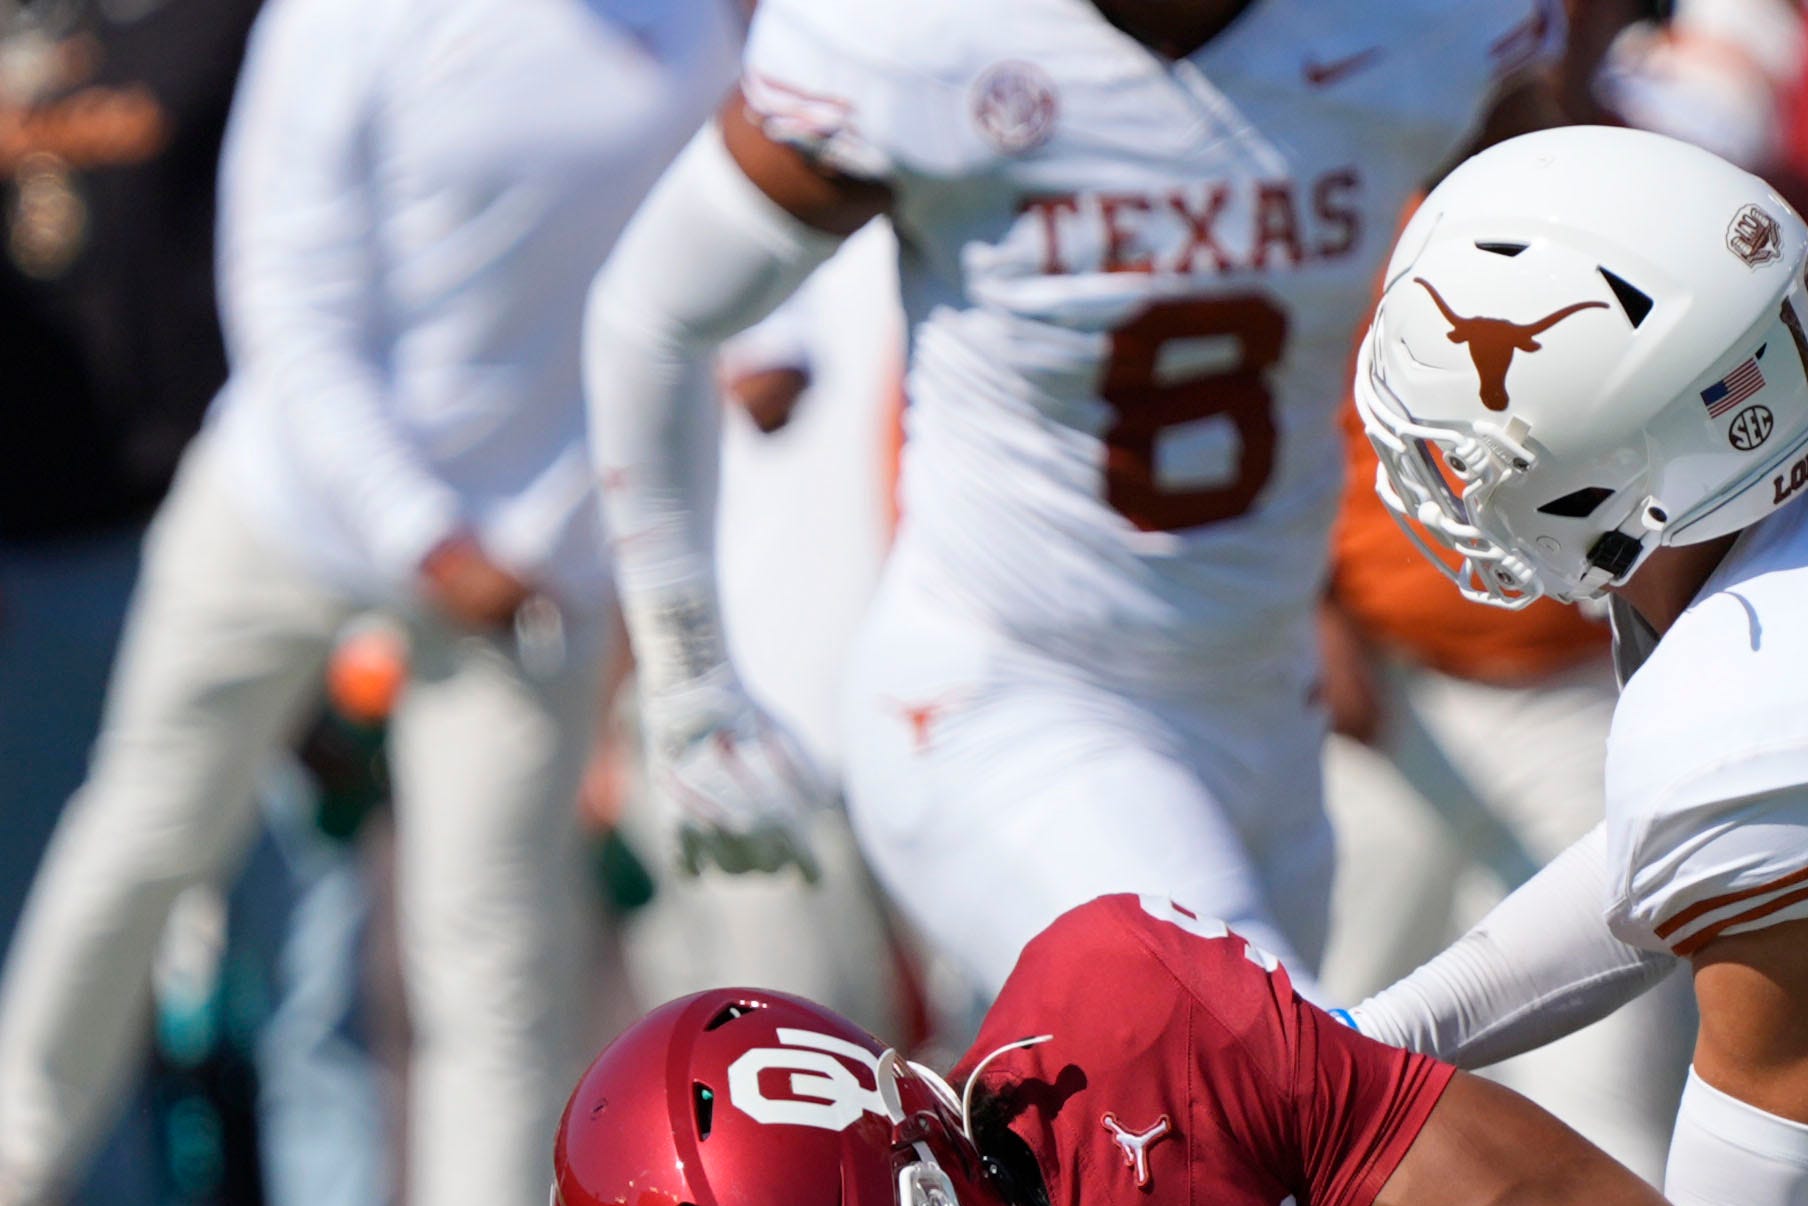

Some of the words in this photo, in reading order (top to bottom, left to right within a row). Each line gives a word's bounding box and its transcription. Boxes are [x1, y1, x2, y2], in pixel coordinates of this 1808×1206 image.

[1021, 168, 1363, 275] TEXAS
[1104, 291, 1290, 532] 8
[1729, 404, 1774, 451] SEC
